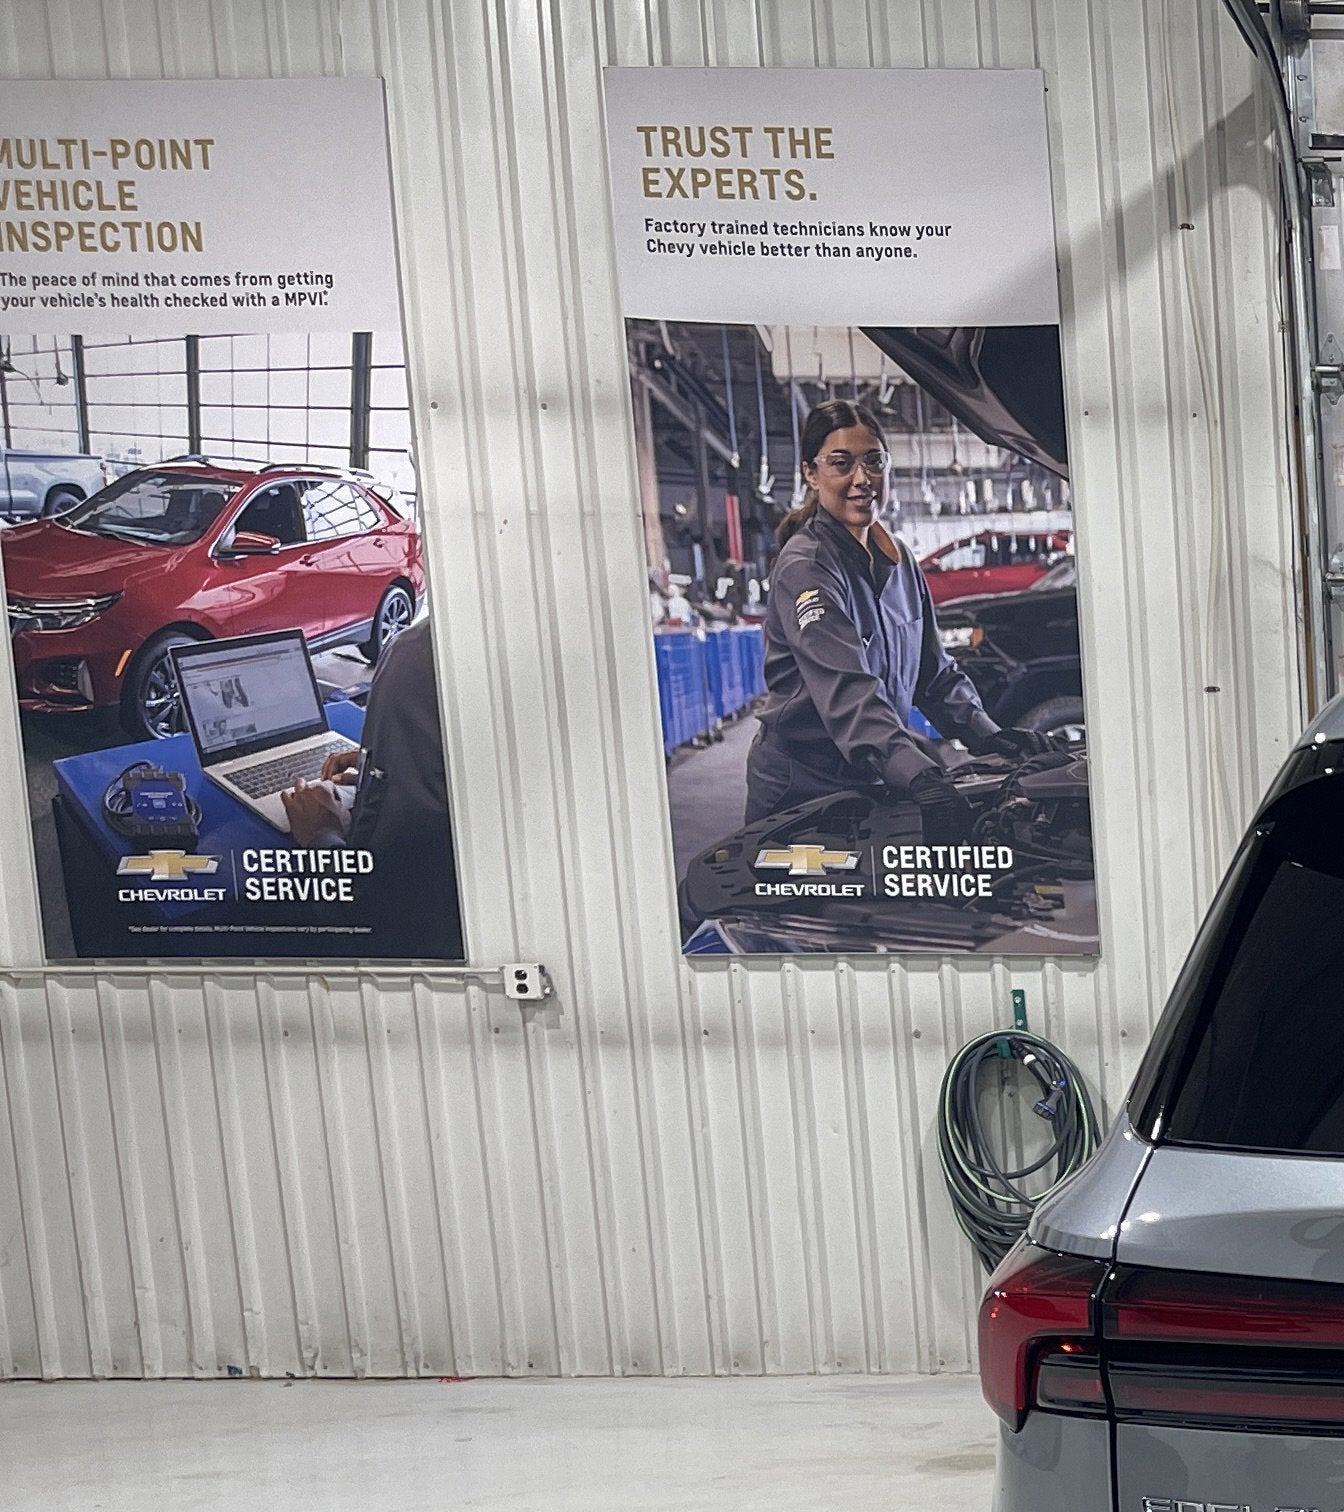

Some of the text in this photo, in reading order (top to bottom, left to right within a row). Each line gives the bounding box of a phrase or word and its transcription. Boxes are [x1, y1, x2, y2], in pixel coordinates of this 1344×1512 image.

[636, 125, 835, 160] TRUST THE
[641, 167, 818, 201] EXPERTS.
[644, 217, 952, 241] Factory trained technicians know your
[646, 238, 918, 262] Chevy vehicle better than anyone.
[0, 270, 334, 291] The peace of mind that comes from getting
[2, 295, 35, 311] your
[40, 292, 107, 308] vehicle's
[110, 292, 160, 308] health
[164, 292, 228, 308] checked
[232, 291, 267, 307] with
[271, 294, 280, 307] a
[242, 849, 375, 875] CERTIFIED
[882, 844, 1014, 870] CERTIFIED
[117, 887, 228, 903] CHEVROLET
[245, 877, 355, 902] SERVICE
[754, 882, 865, 898] CHEVROLET
[884, 873, 994, 898] SERVICE
